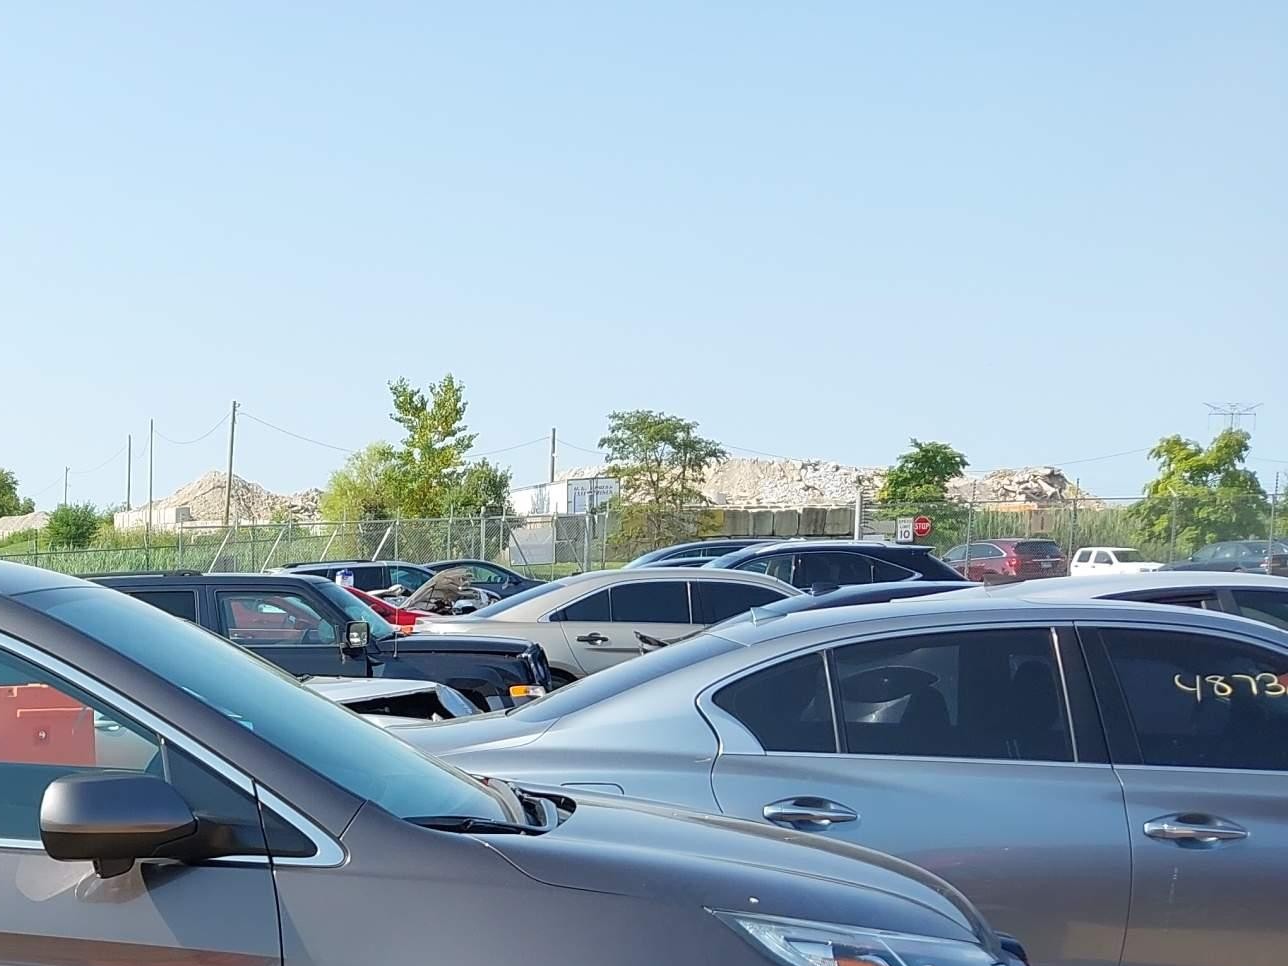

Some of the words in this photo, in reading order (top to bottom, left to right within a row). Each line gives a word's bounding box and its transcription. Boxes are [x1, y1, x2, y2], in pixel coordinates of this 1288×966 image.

[915, 522, 931, 530] STOP
[900, 530, 911, 539] 10
[1174, 672, 1288, 703] 4873
